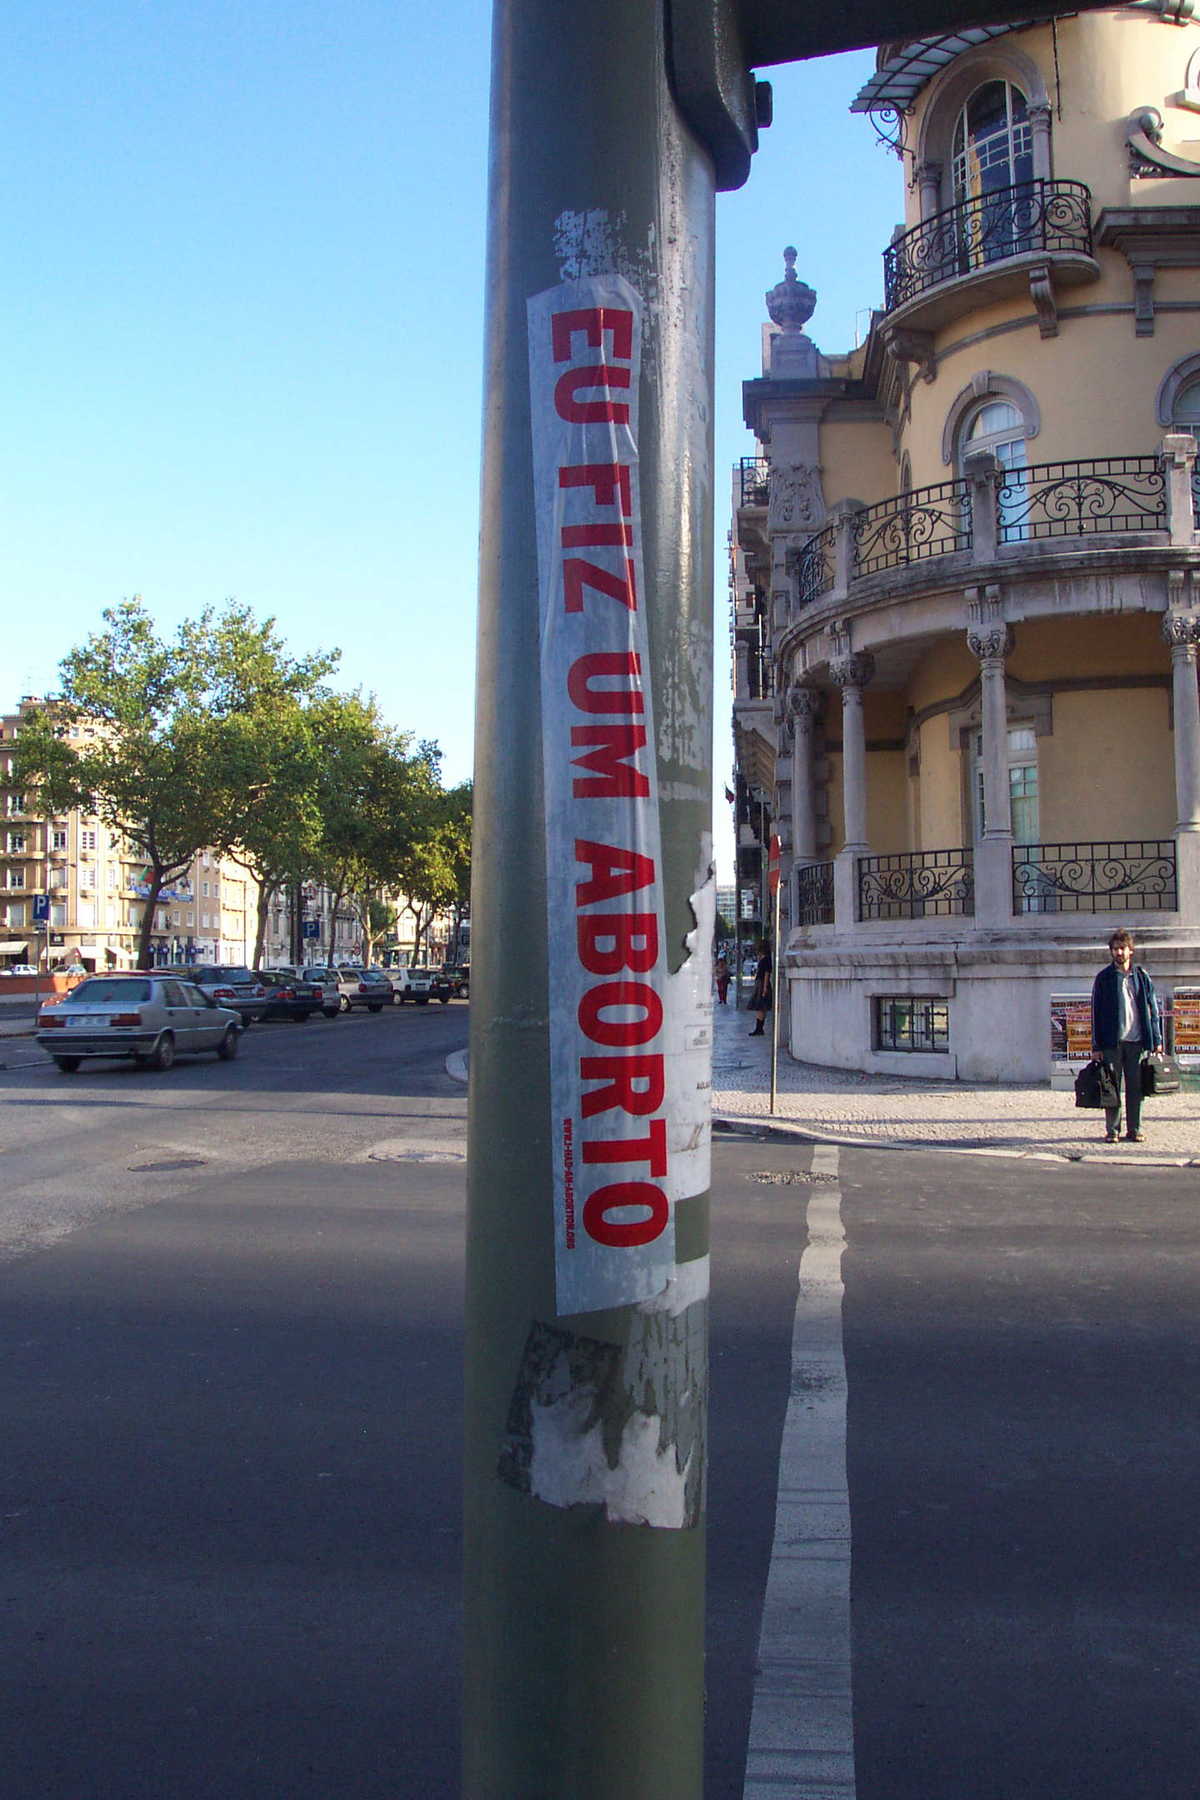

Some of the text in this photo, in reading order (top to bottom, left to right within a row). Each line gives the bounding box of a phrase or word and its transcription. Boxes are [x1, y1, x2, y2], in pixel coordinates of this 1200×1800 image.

[551, 307, 670, 1248] EU FIZ UM ABORTO
